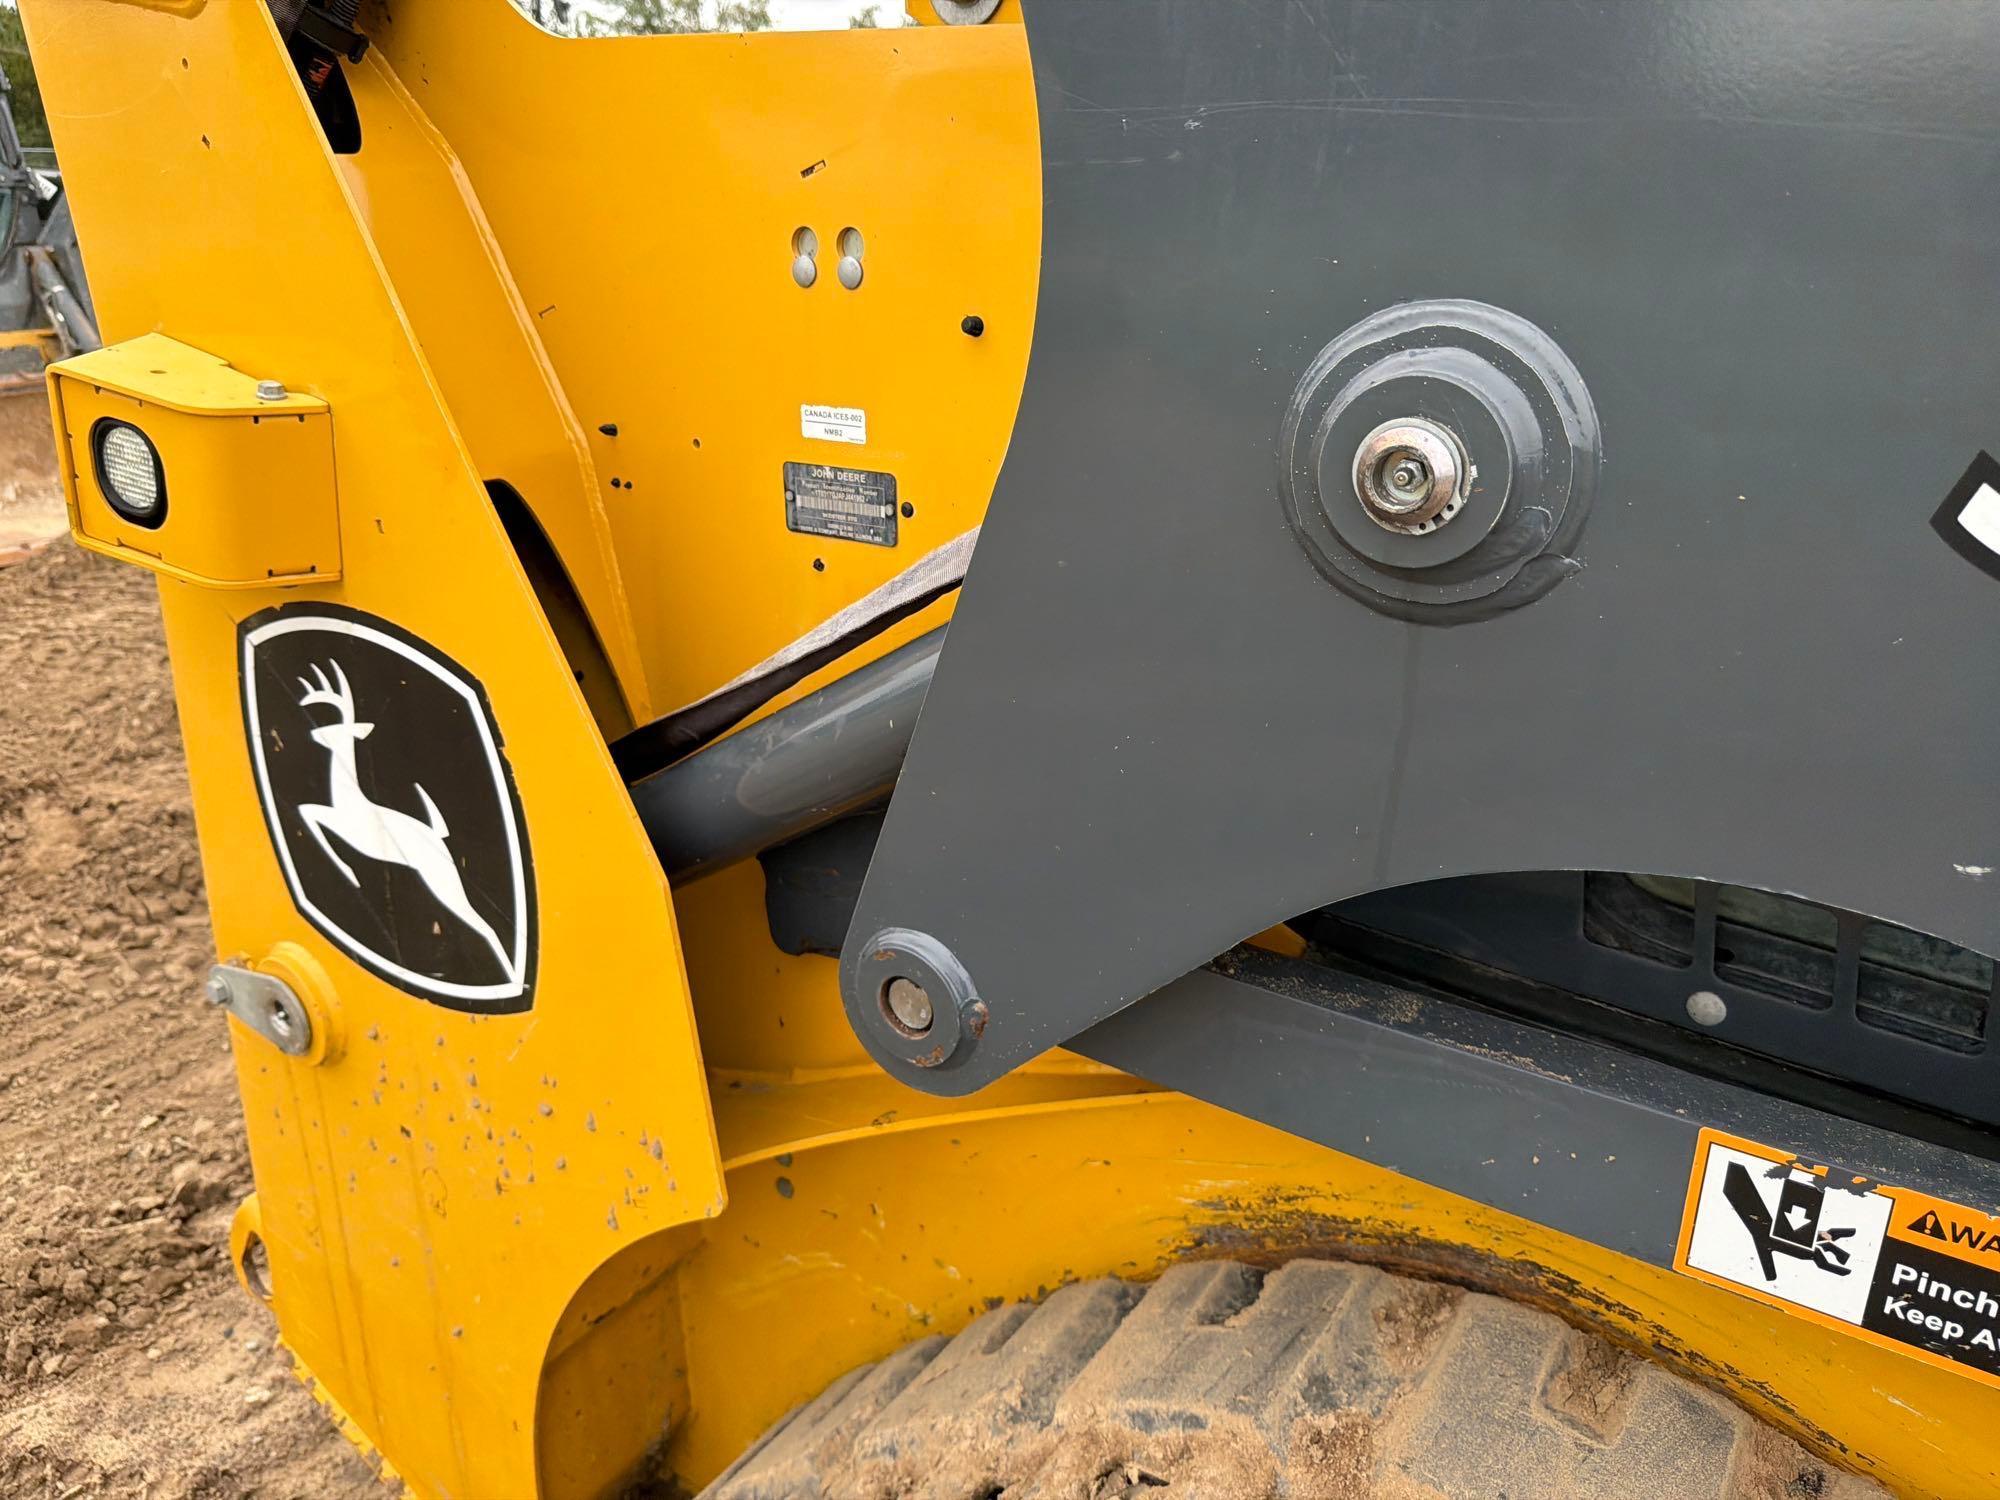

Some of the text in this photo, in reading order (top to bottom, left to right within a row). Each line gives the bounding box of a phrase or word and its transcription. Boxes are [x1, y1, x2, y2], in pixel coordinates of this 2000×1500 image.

[804, 409, 863, 423] CANADA ICES-002
[824, 428, 844, 437] NMB2
[811, 469, 866, 483] JOHN DEERE
[1892, 1263, 1999, 1318] Pinch
[1884, 1296, 2000, 1352] Keep A
